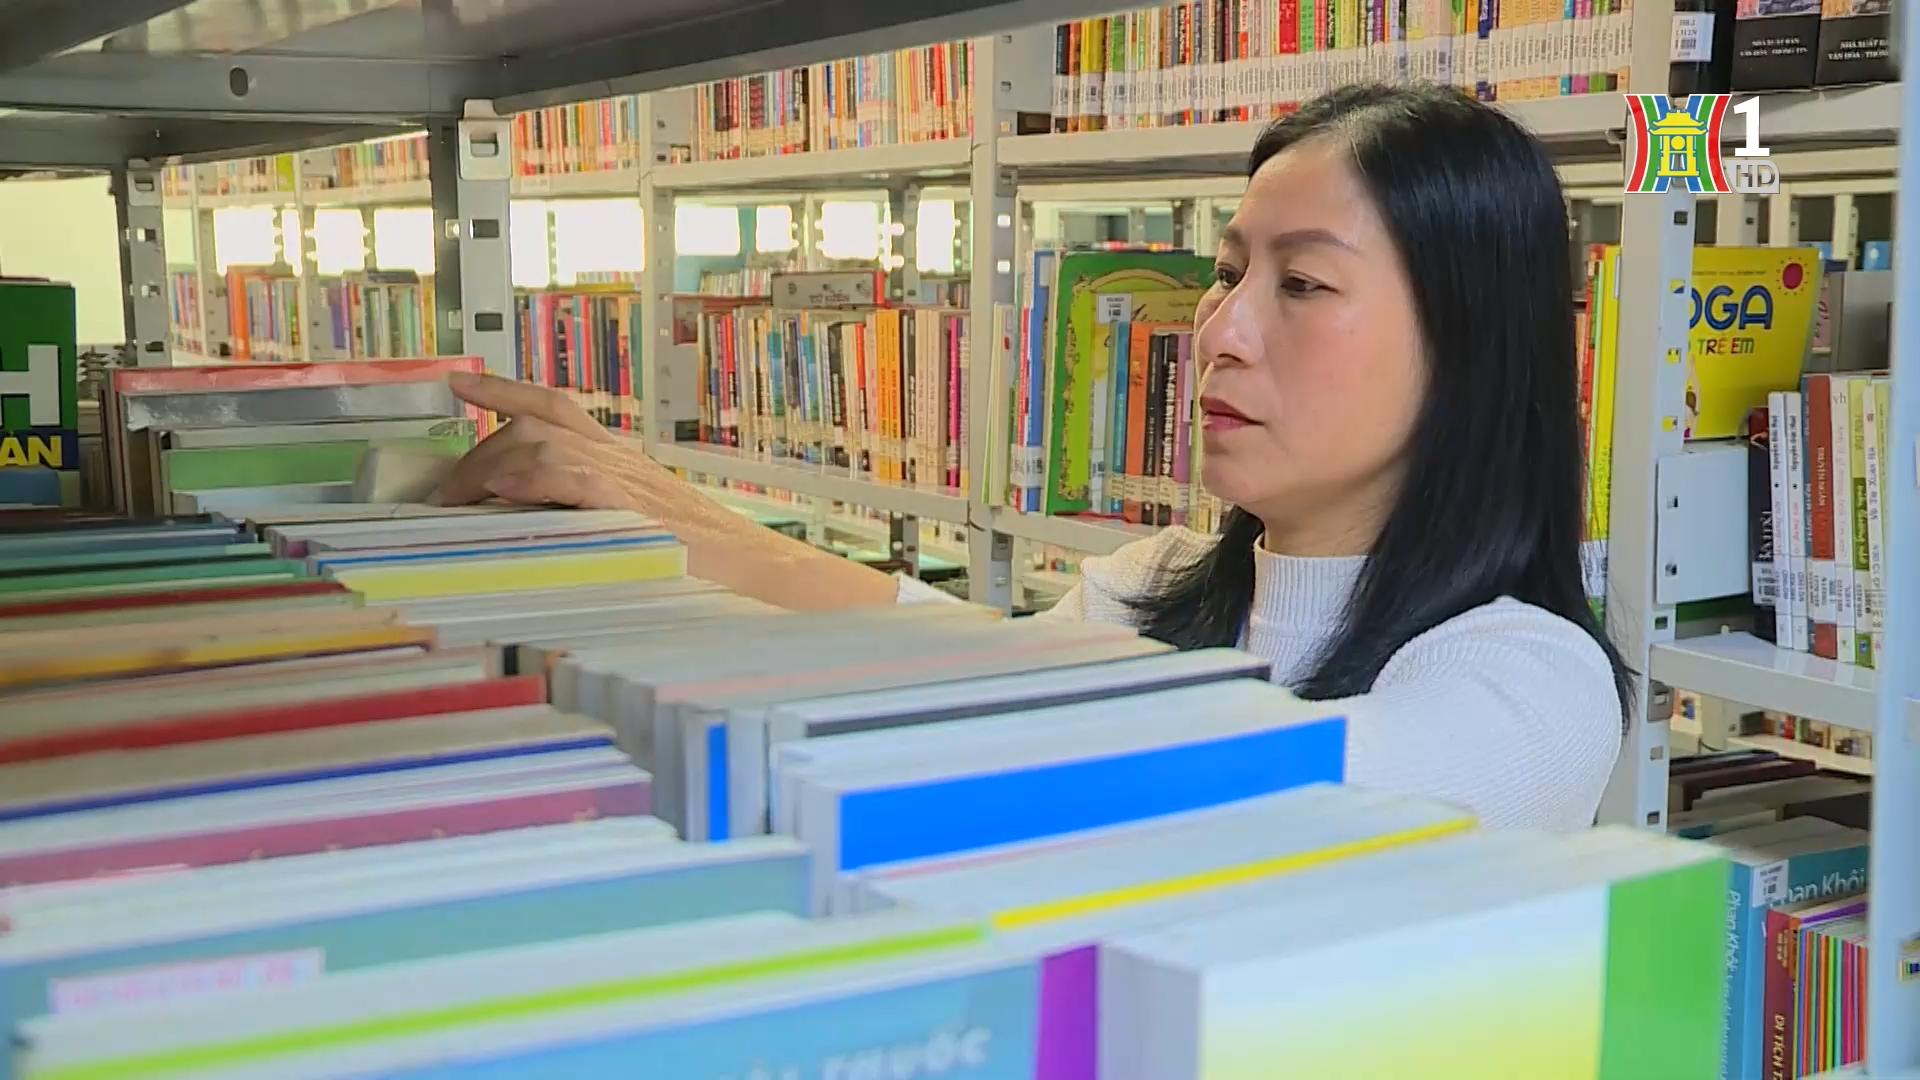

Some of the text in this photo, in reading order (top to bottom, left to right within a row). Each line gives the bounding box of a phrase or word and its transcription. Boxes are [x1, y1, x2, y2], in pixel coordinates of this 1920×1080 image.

[1696, 333, 1728, 355] TRẺ
[1832, 392, 1847, 405] vh
[1822, 867, 1866, 896] Khôi
[1726, 889, 1741, 931] Phan
[1726, 932, 1741, 971] Khôi
[1773, 1034, 1785, 1067] TÍCH
